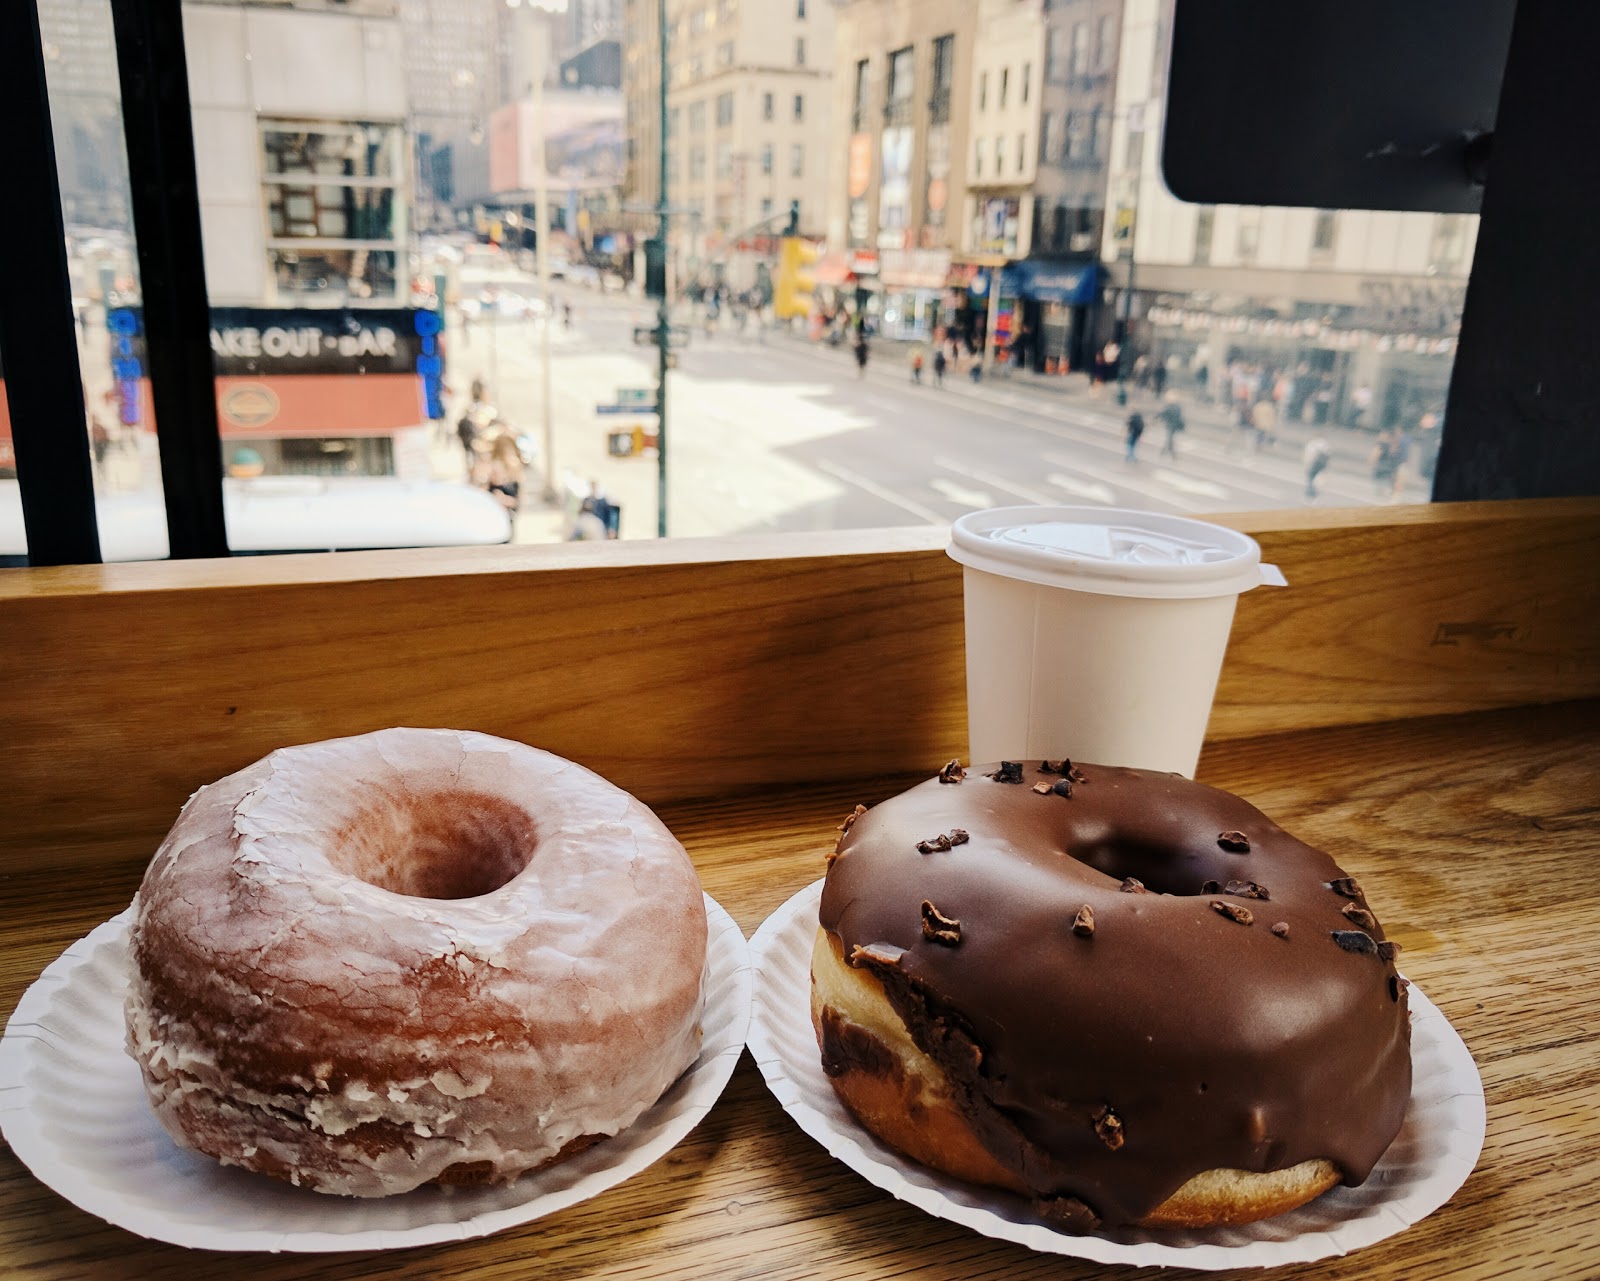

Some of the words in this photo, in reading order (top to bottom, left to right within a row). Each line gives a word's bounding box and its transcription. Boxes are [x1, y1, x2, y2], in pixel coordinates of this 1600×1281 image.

[210, 326, 262, 357] AKE
[262, 326, 322, 357] OUT
[338, 327, 396, 356] BAR
